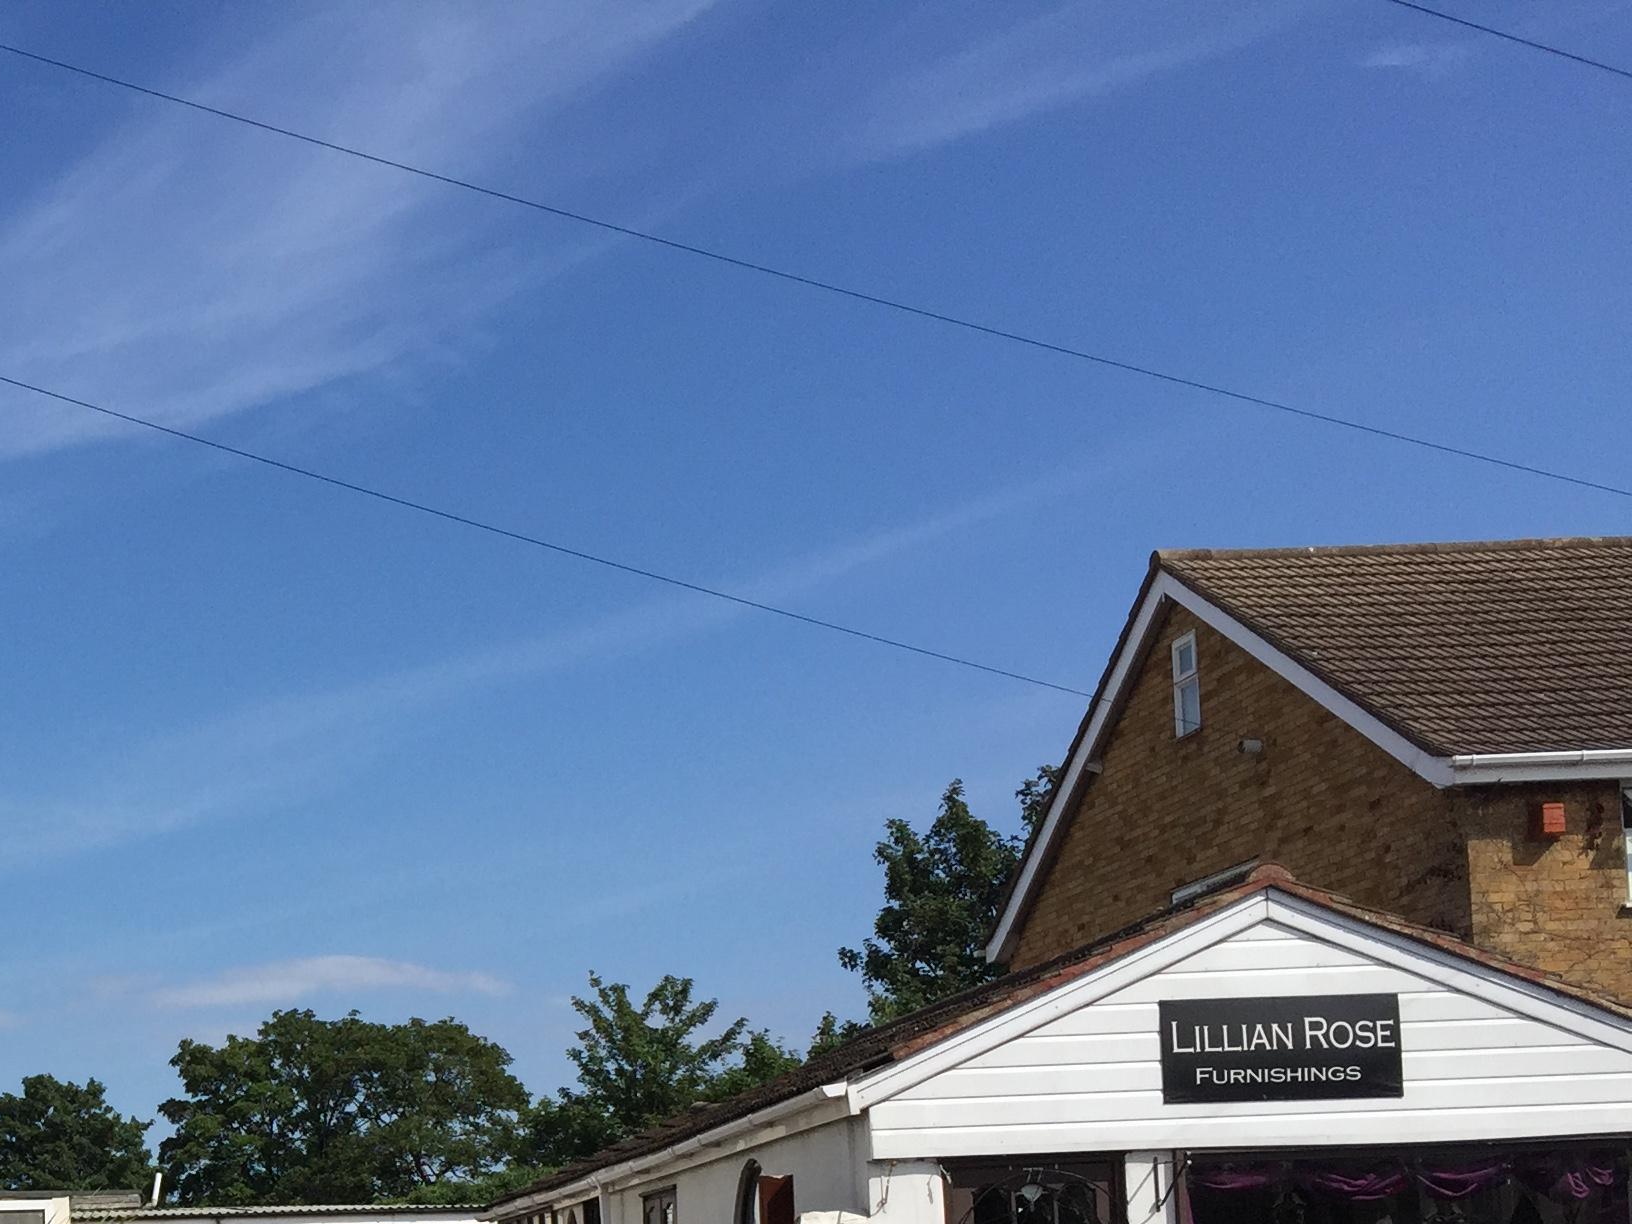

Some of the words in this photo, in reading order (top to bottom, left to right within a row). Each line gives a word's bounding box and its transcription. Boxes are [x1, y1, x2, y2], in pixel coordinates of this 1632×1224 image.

[1171, 1020, 1294, 1053] LILLIAN
[1304, 1016, 1396, 1050] ROSE
[1195, 1065, 1362, 1085] FURNISHINGS
